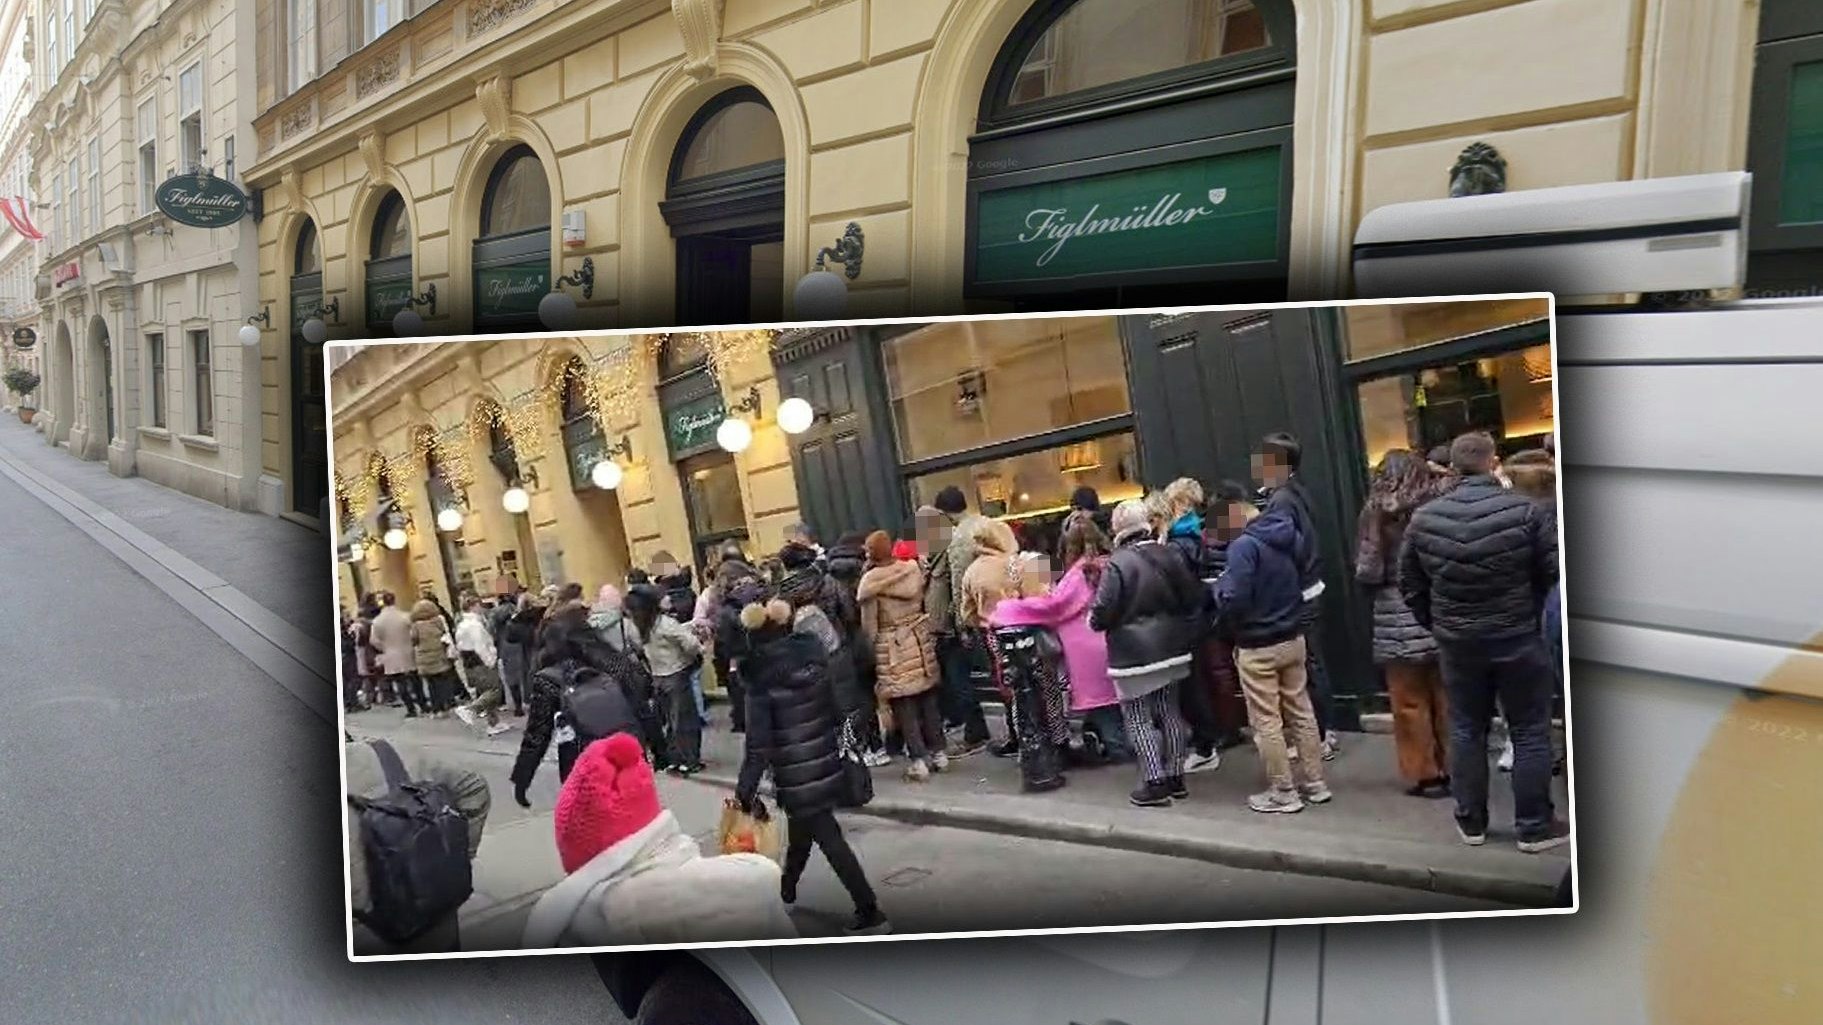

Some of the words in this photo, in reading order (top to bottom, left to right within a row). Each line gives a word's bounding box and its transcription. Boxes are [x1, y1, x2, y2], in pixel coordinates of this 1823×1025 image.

[164, 188, 240, 208] Figlmüller
[1018, 192, 1213, 267] Figlmüller
[488, 277, 540, 310] Figlmüller
